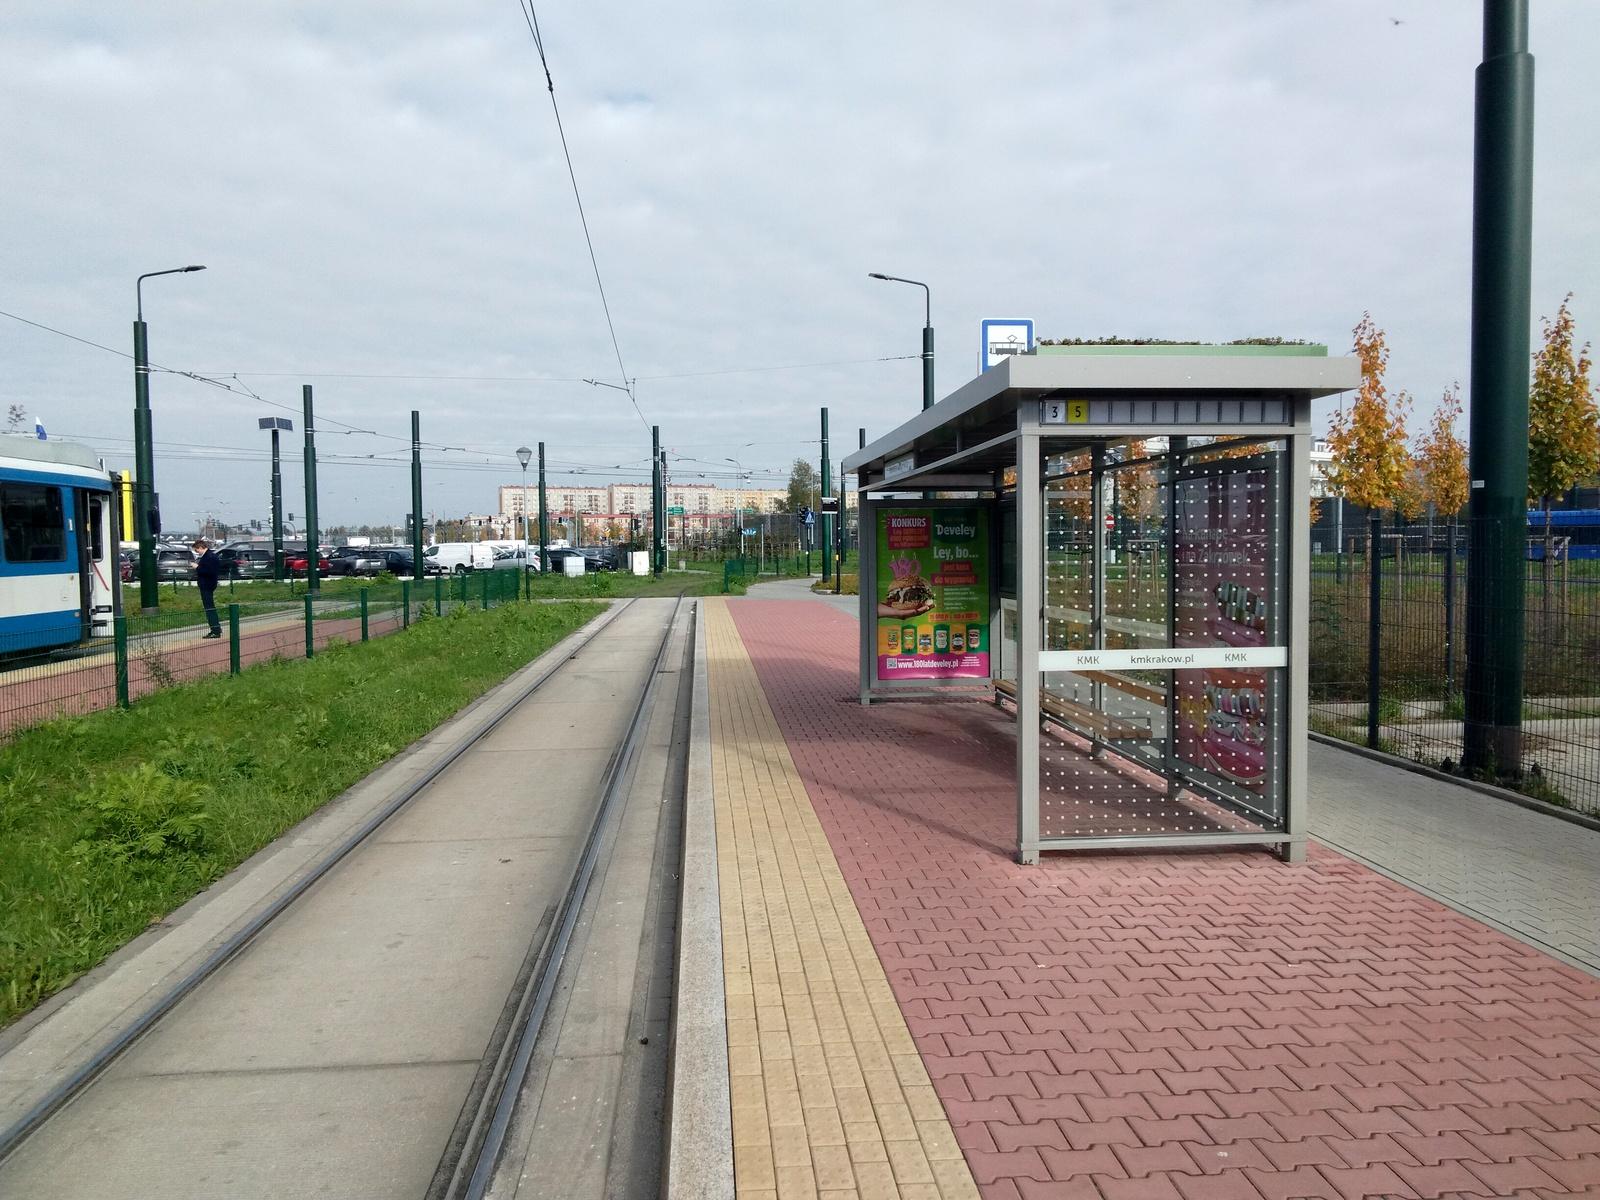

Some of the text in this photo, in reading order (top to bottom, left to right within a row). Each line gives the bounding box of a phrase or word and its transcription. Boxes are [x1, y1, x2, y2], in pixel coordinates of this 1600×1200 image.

[1051, 406, 1082, 418] 3 5
[891, 517, 927, 528] KONKURS
[935, 524, 976, 538] Develey
[933, 546, 979, 560] Ley, bo...
[1077, 653, 1247, 666] KMK kmkrakow.pl KMK
